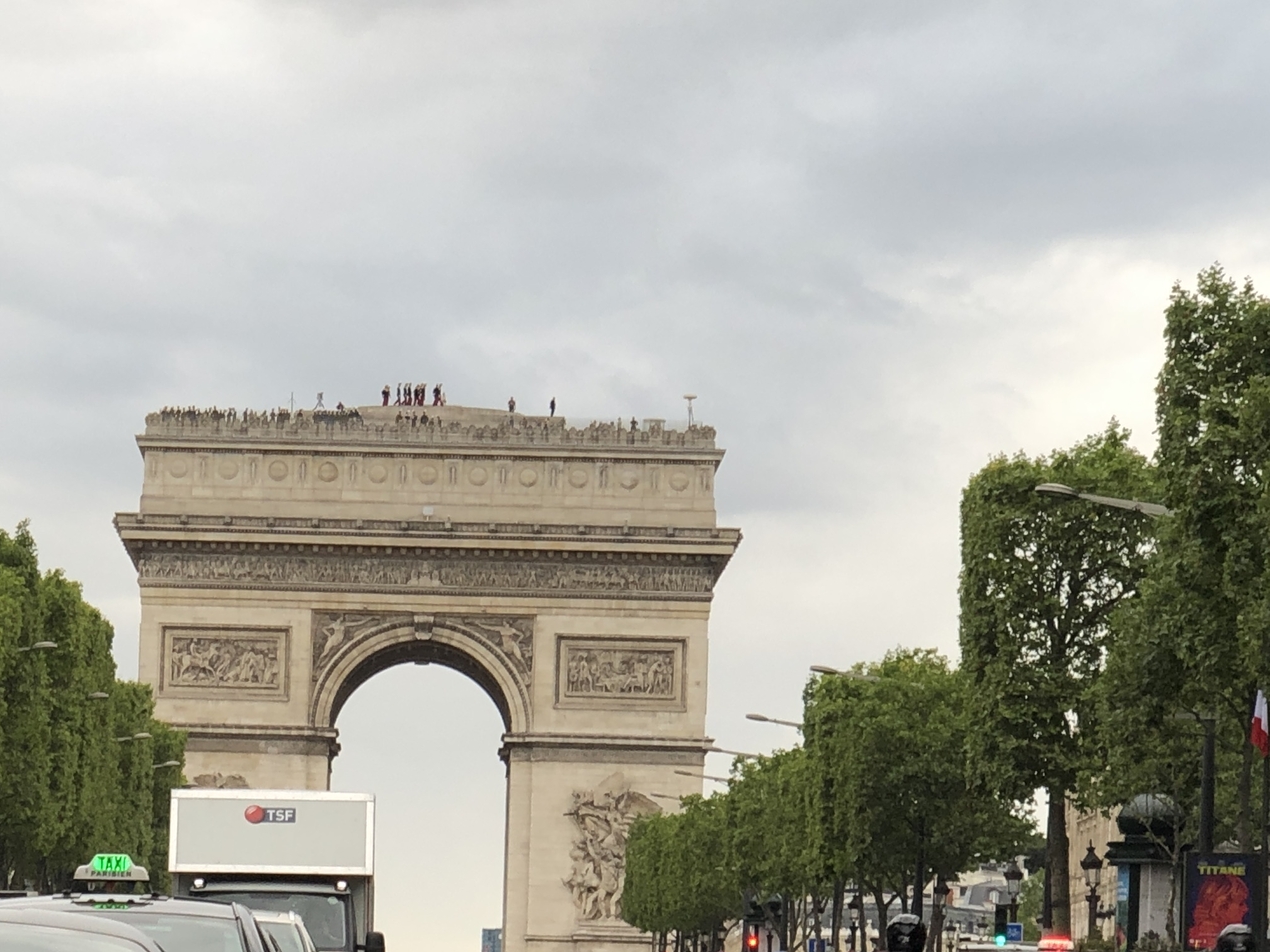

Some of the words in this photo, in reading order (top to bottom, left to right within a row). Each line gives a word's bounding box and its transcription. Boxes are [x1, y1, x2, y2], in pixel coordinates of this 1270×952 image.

[266, 810, 294, 821] TSF
[98, 856, 127, 870] TAXI
[1198, 865, 1246, 876] TITANE
